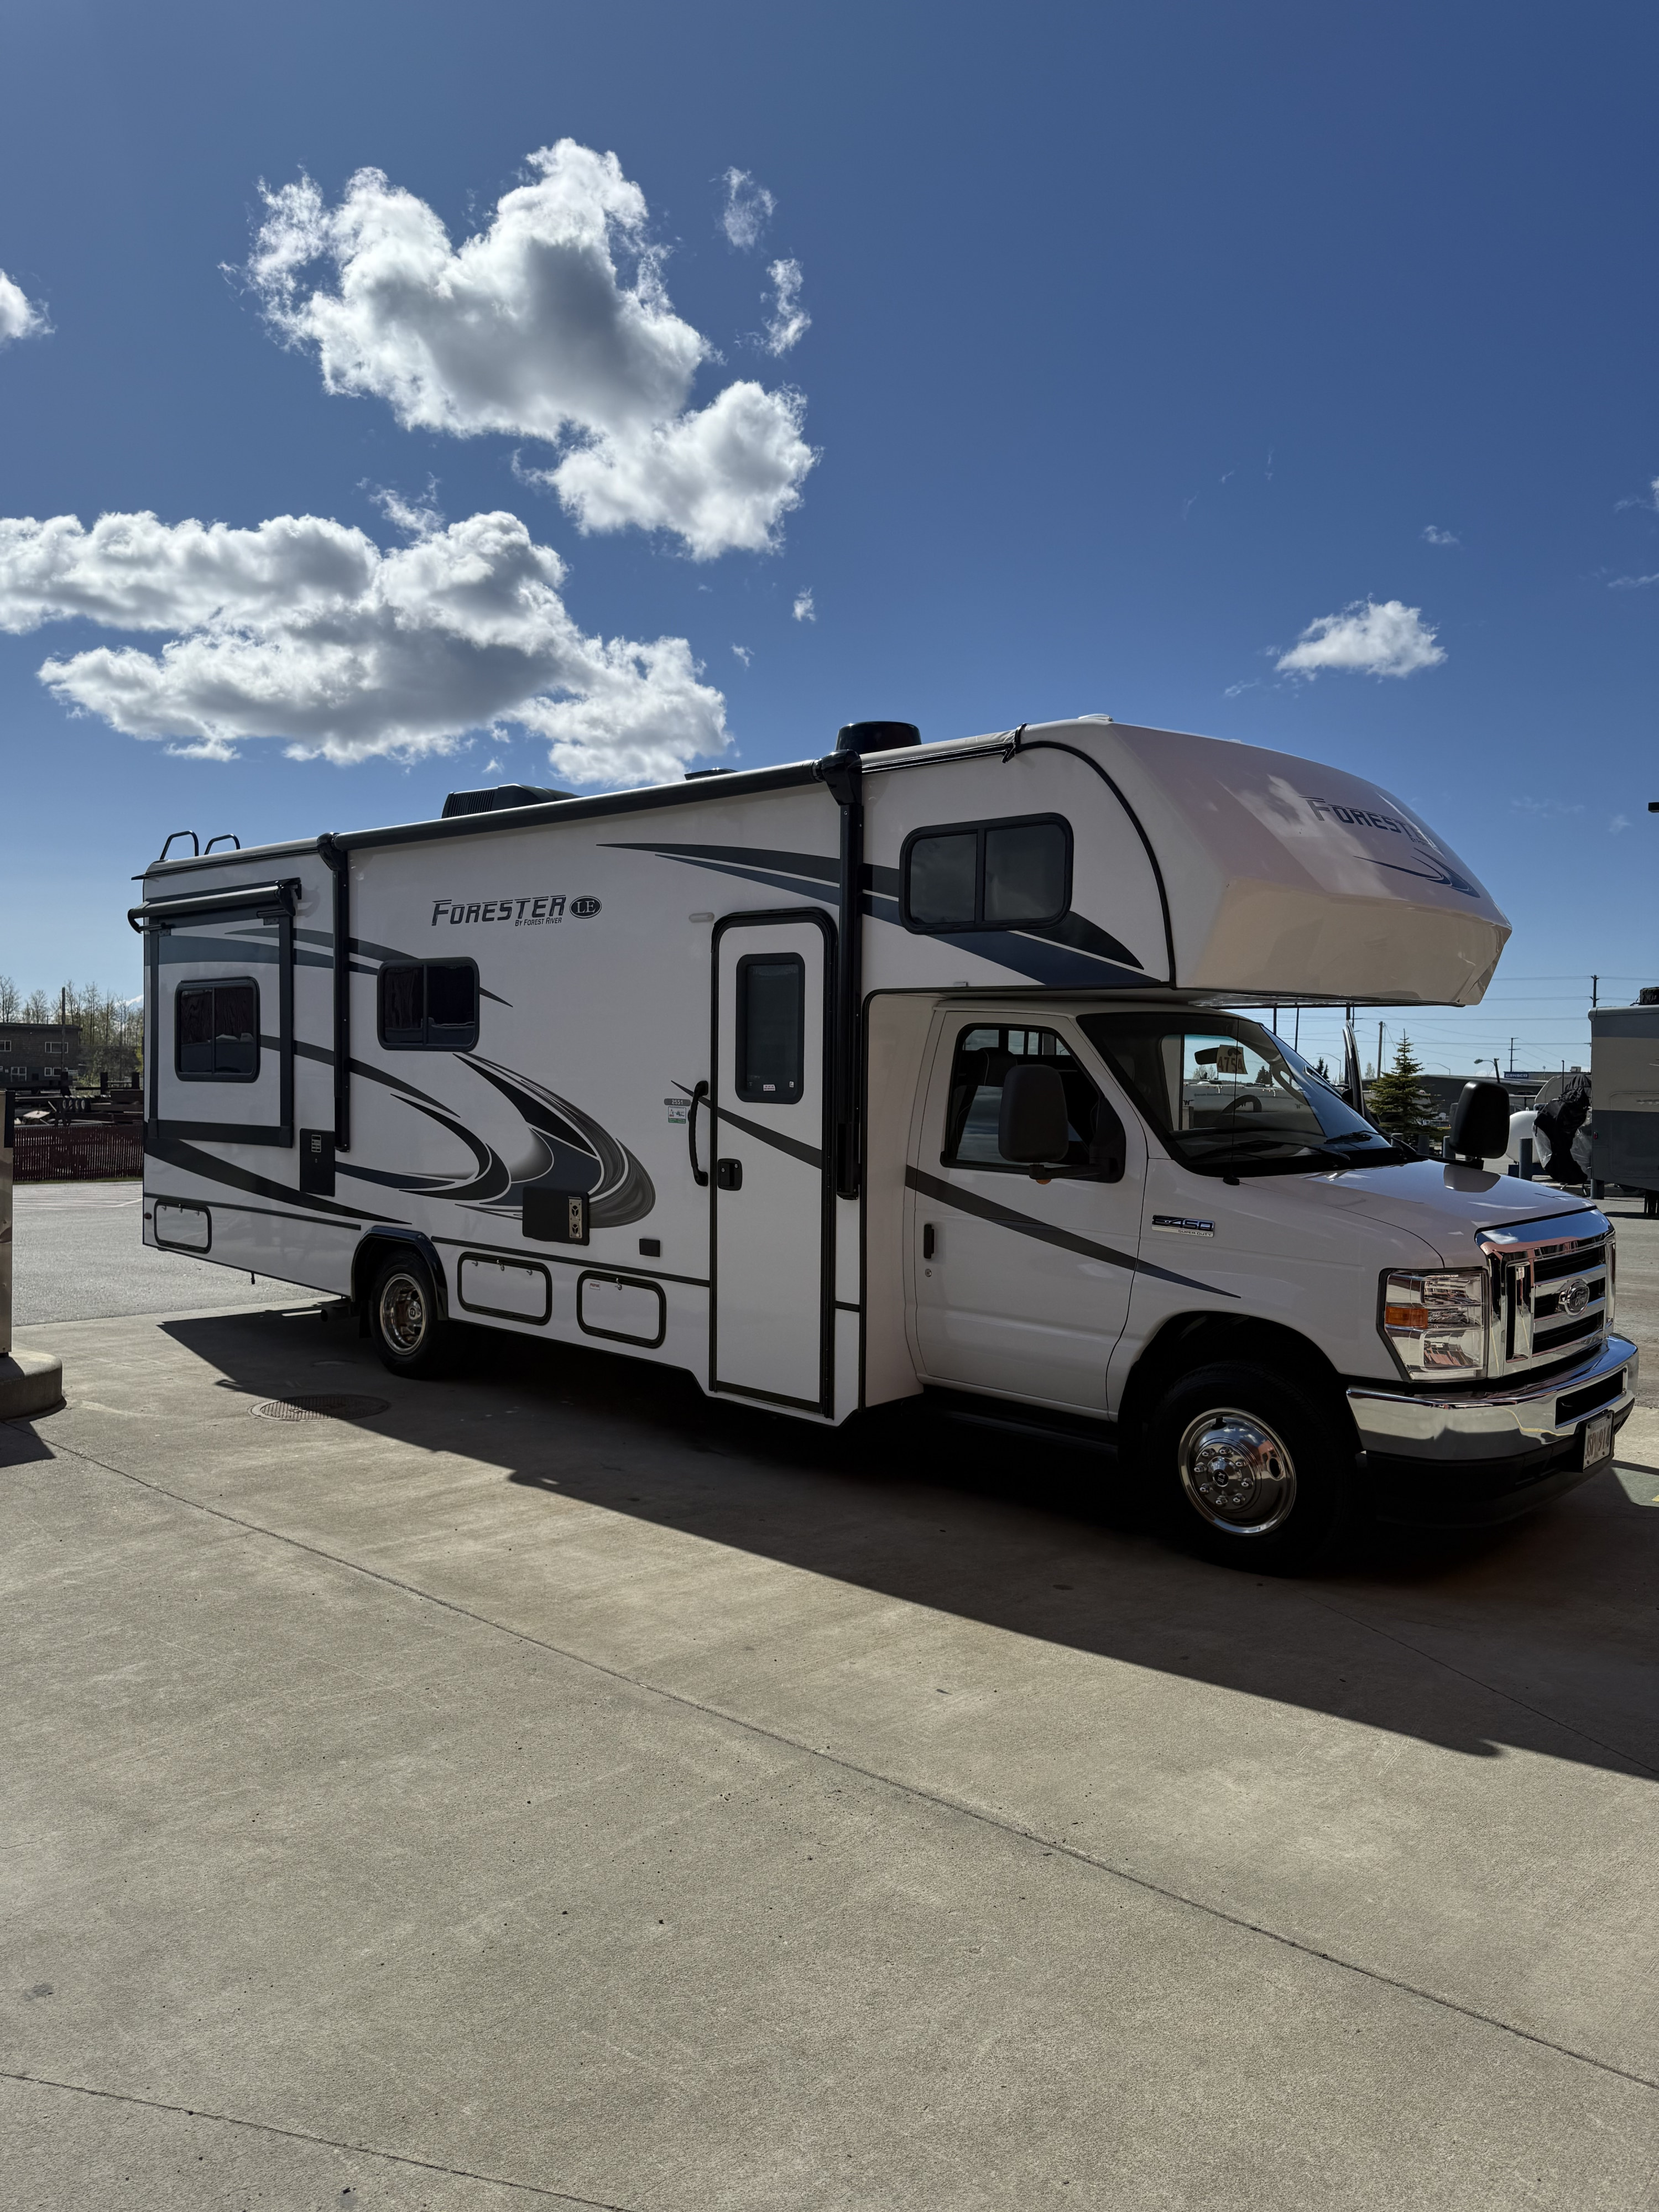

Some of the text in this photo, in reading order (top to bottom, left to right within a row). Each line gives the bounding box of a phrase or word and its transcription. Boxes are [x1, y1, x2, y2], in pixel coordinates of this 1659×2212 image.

[431, 894, 566, 926] FORESTER
[524, 918, 545, 926] FOREST
[1218, 1056, 1245, 1073] 4754
